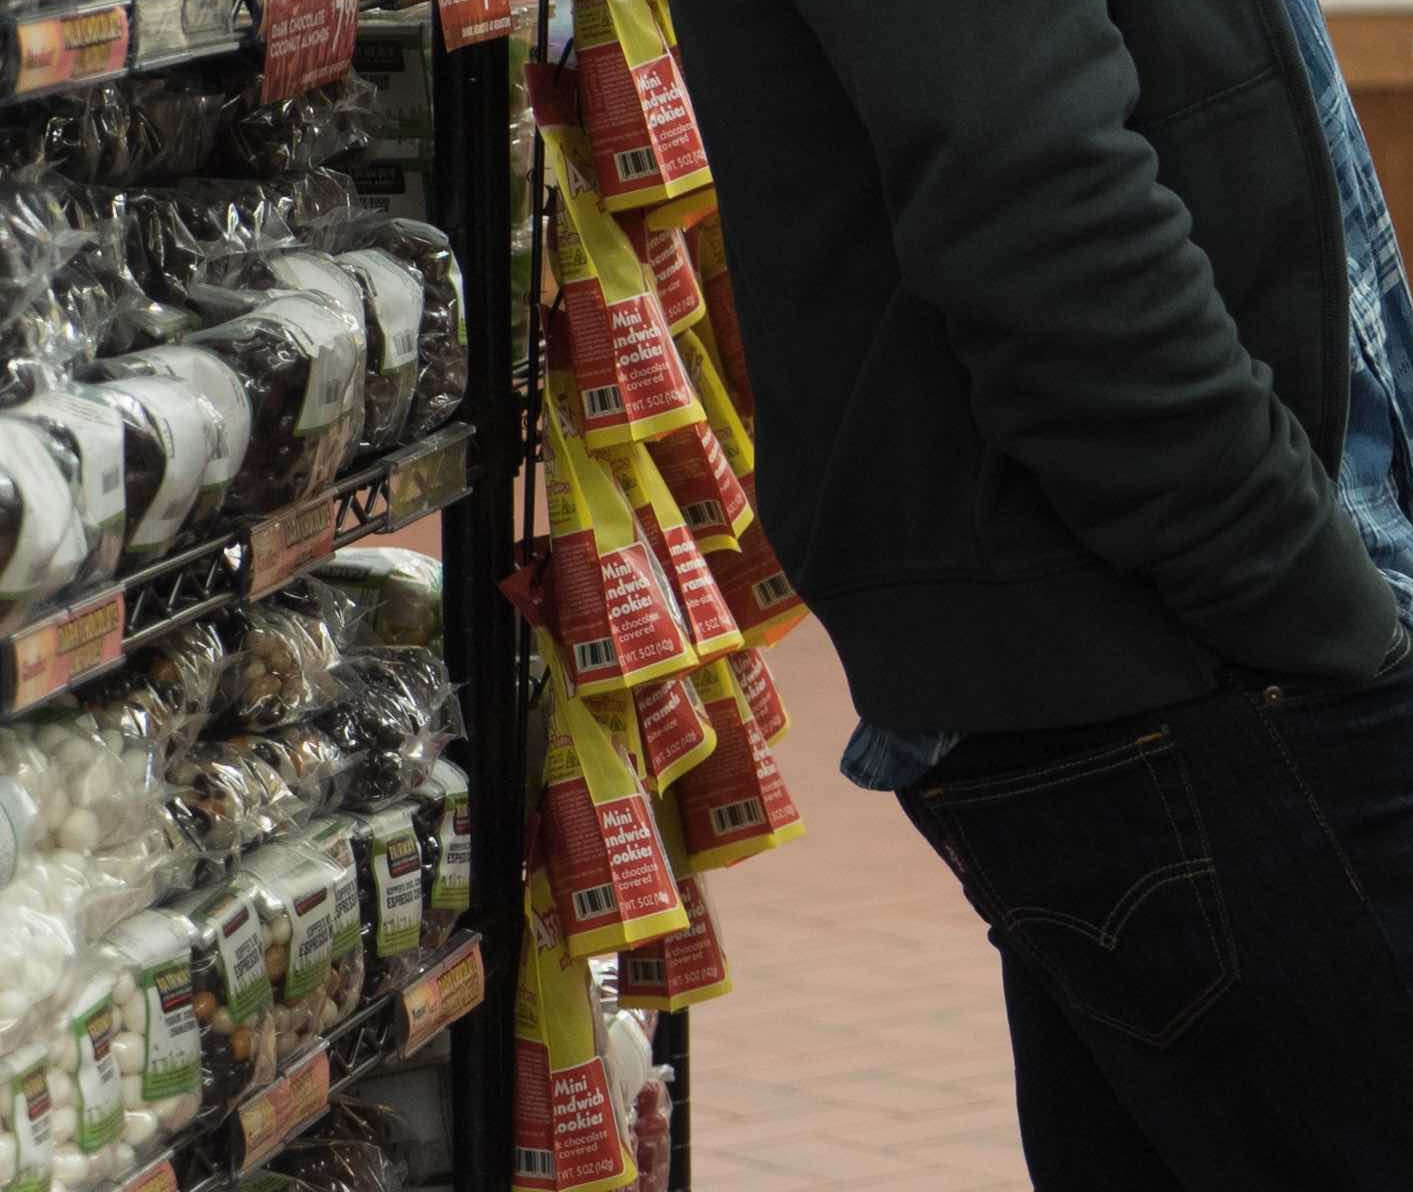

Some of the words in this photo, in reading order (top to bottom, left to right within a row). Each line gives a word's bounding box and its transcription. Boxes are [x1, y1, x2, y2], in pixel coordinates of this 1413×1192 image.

[637, 71, 662, 92] Mini
[641, 87, 686, 110] ndwich
[611, 308, 642, 330] Mini
[614, 321, 663, 348] ndwich
[626, 374, 664, 392] covered
[602, 559, 631, 580] Mini
[618, 624, 655, 642] covered
[643, 694, 680, 726] ramels
[603, 808, 633, 829] Mini
[606, 820, 651, 848] ndwich
[554, 1075, 587, 1096] Mini
[554, 1089, 604, 1115] ndwich
[564, 1130, 608, 1149] chocolate
[559, 1142, 598, 1159] covered
